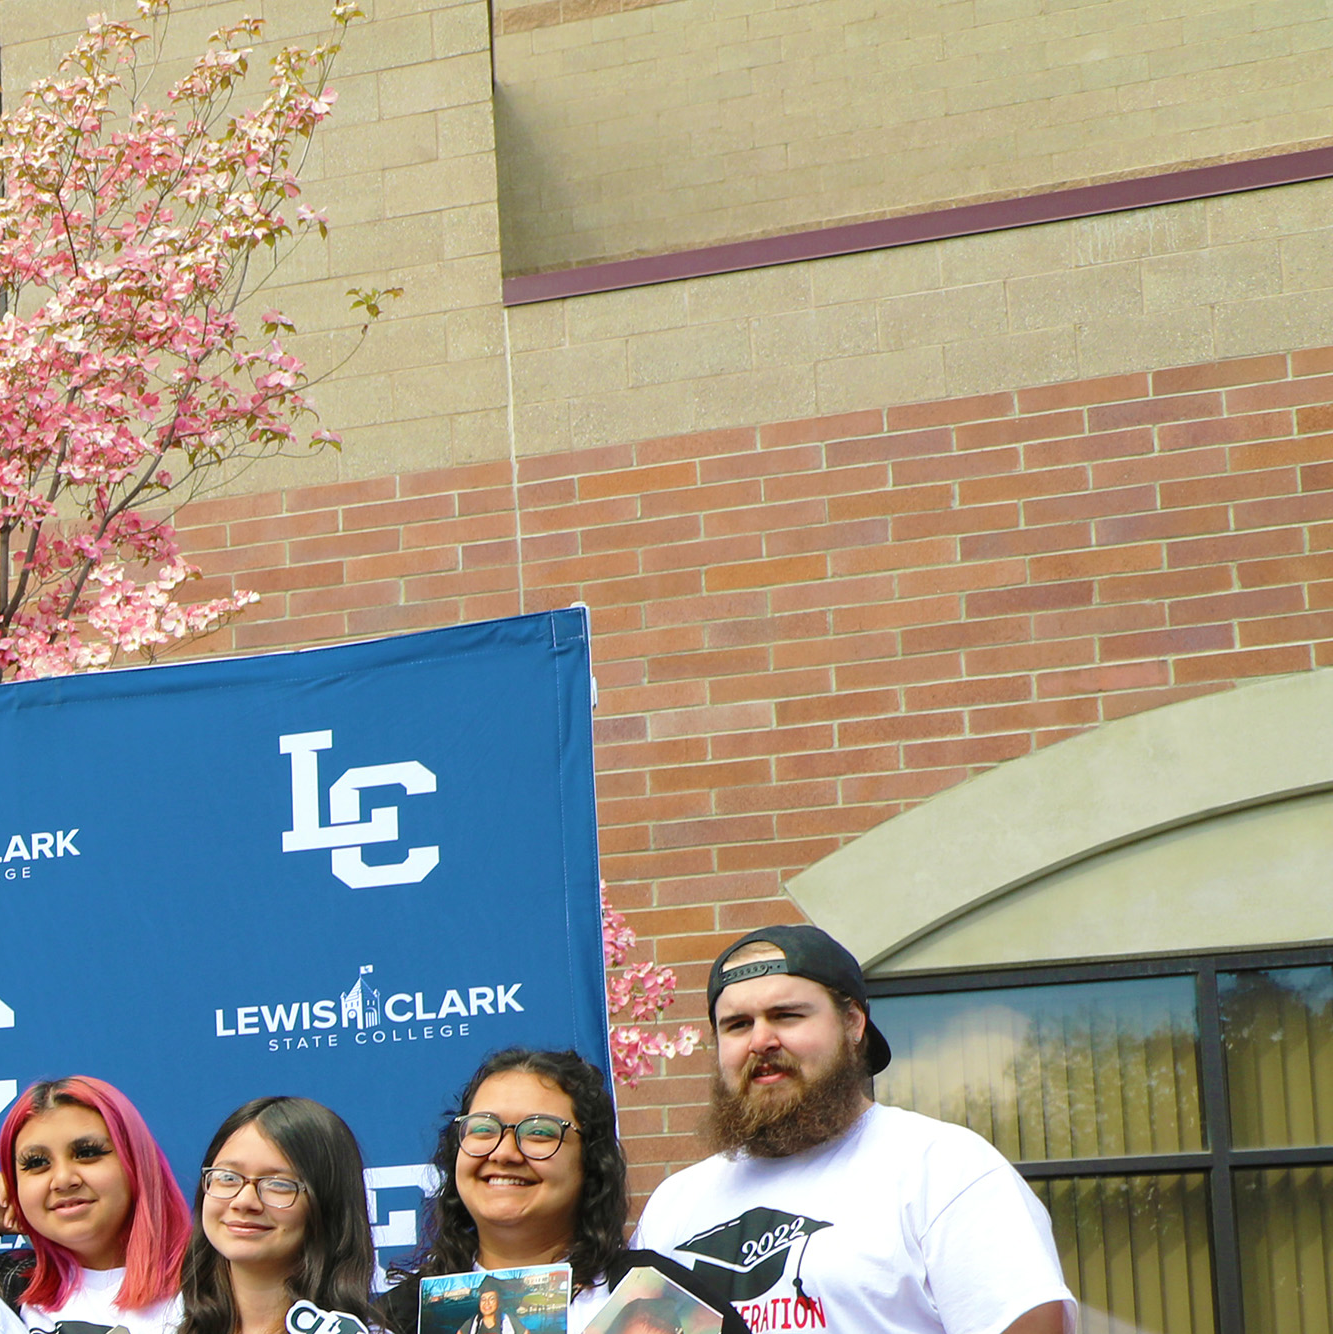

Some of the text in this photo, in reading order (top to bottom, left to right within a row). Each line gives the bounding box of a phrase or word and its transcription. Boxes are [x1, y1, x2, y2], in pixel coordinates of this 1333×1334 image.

[280, 730, 439, 888] LC
[216, 984, 523, 1038] LEWIS CLARK
[270, 1021, 467, 1050] STATE COLLEGE
[741, 1217, 806, 1265] 2022
